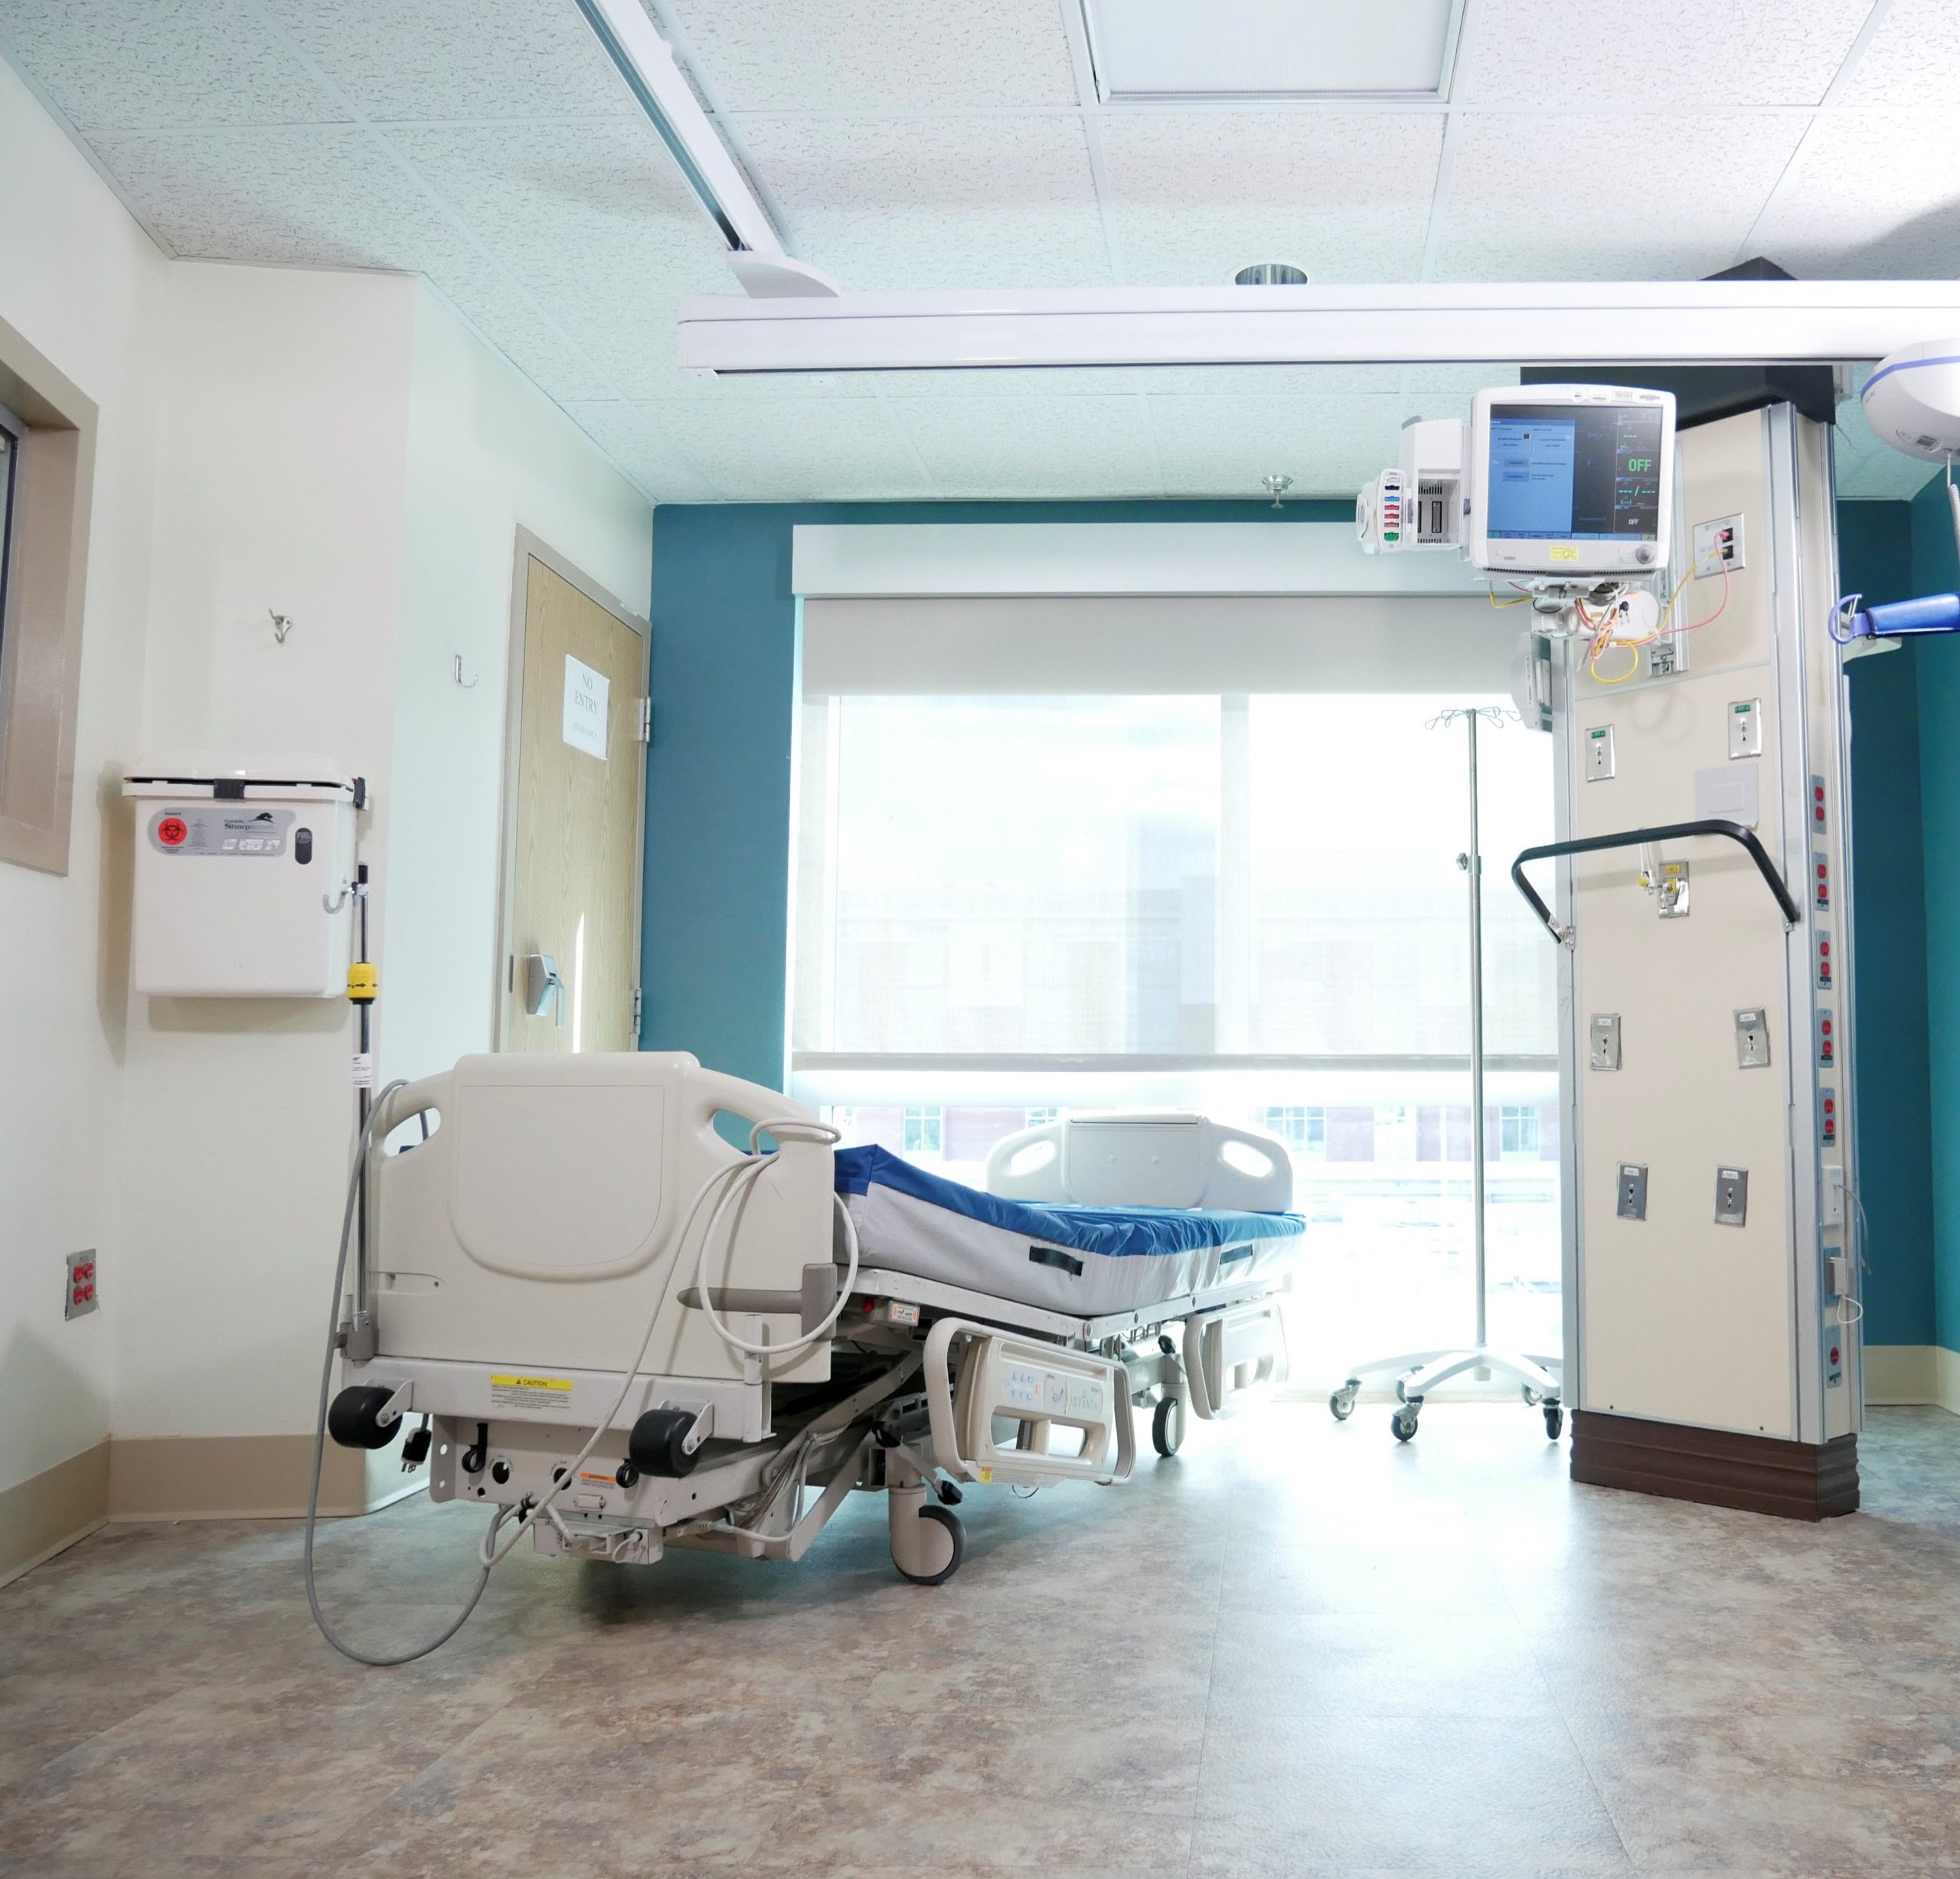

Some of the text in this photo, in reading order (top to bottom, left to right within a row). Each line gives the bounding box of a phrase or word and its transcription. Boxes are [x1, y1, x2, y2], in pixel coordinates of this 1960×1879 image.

[1628, 459, 1652, 472] OFF
[582, 673, 593, 691] NO
[575, 690, 598, 714] ENTRY
